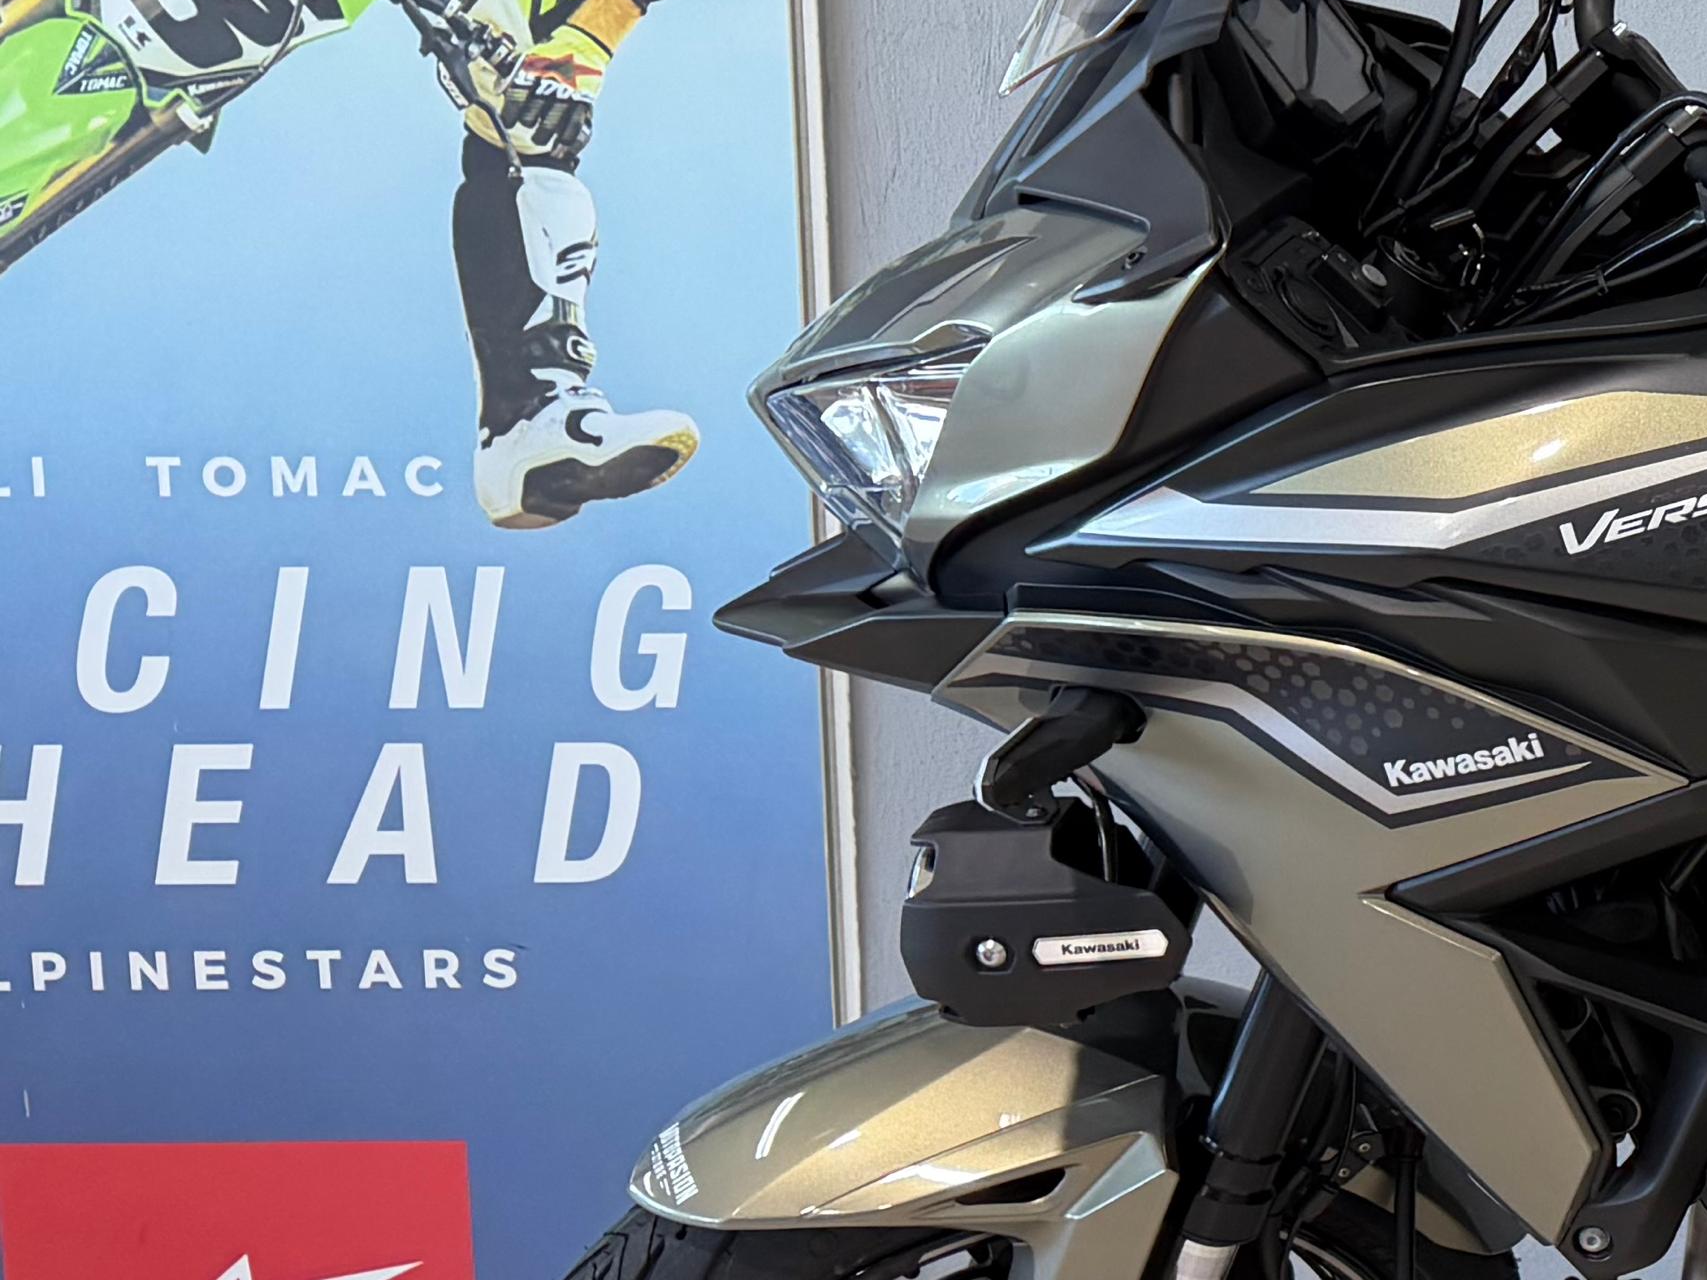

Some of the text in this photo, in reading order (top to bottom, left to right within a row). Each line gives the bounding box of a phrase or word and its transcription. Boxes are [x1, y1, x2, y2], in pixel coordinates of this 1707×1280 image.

[146, 456, 443, 496] TOMAC
[76, 565, 692, 713] CING
[1384, 733, 1545, 787] Kawasaki
[1061, 939, 1140, 955] Kawasaki
[0, 949, 518, 991] PINESTARS
